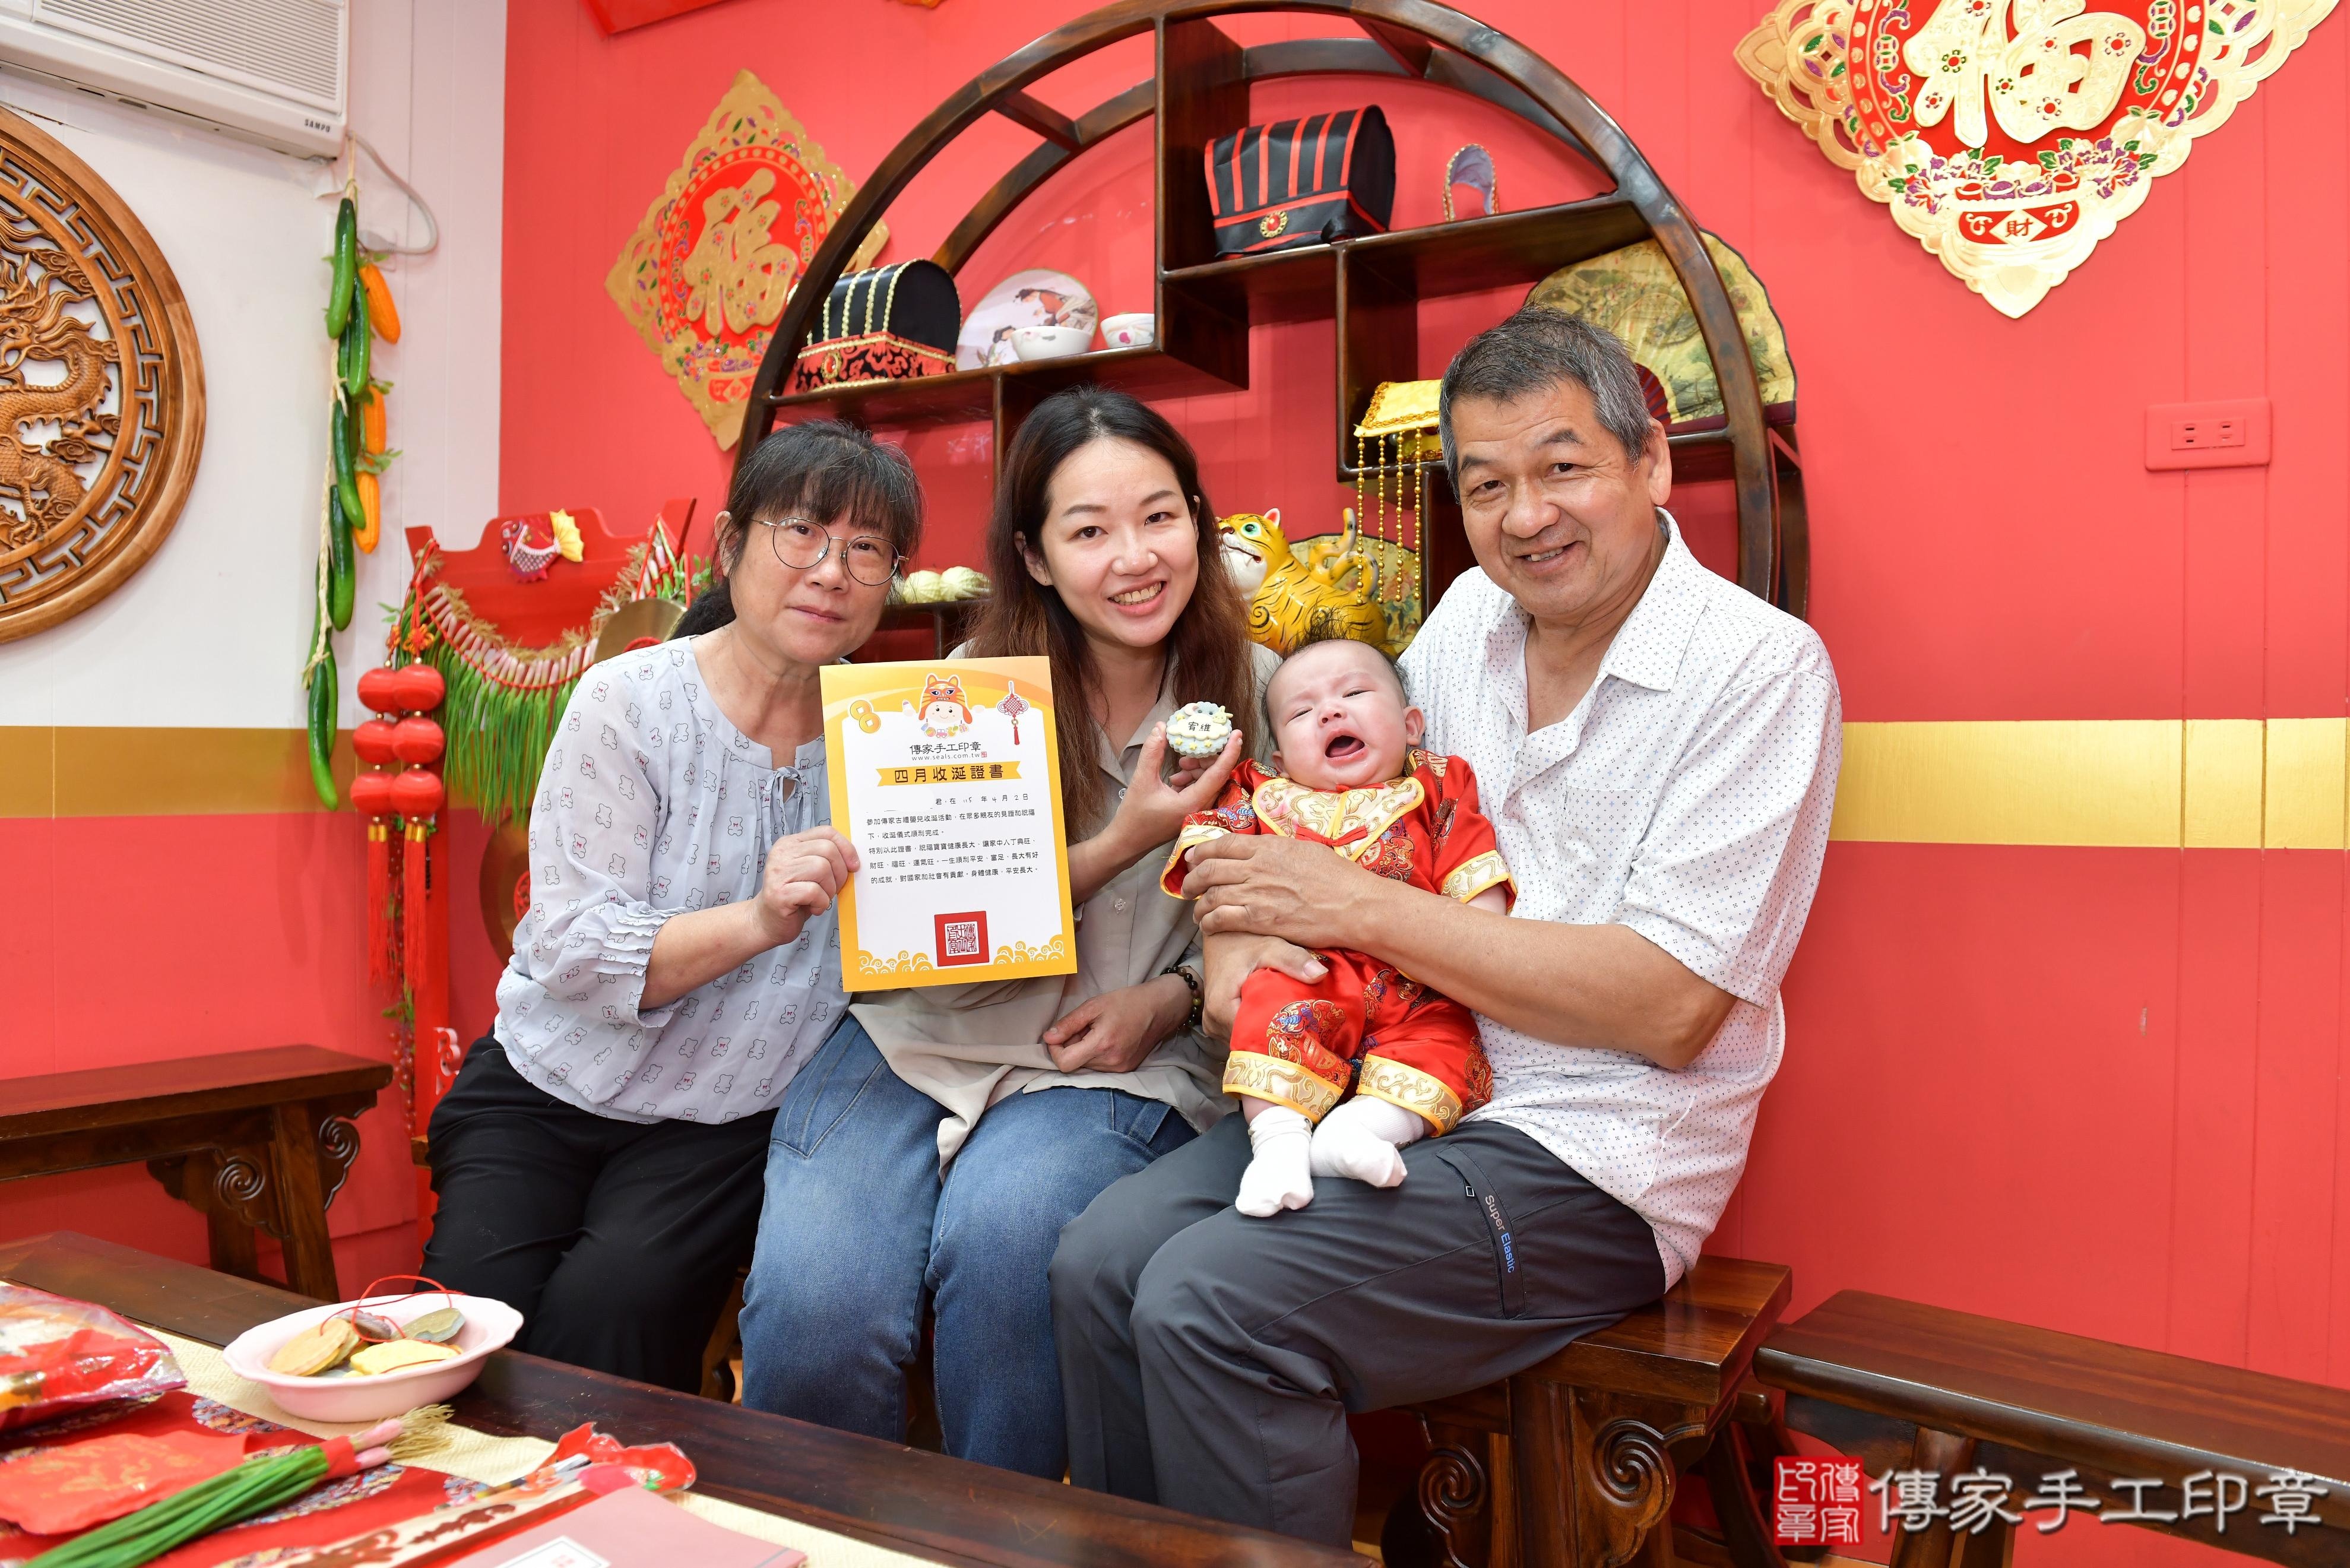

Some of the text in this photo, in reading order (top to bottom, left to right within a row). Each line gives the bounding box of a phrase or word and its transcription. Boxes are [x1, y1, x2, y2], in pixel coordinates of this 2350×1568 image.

[1902, 0, 2146, 148] 福
[304, 119, 331, 132] SAMPO
[2005, 218, 2034, 237] 財
[683, 167, 798, 335] 福
[910, 742, 981, 755] 傳家手工印章
[911, 752, 980, 761] www.seals.com.tw
[895, 764, 1003, 783] 四月收涎證書
[1485, 1195, 1515, 1273] Super Elastic
